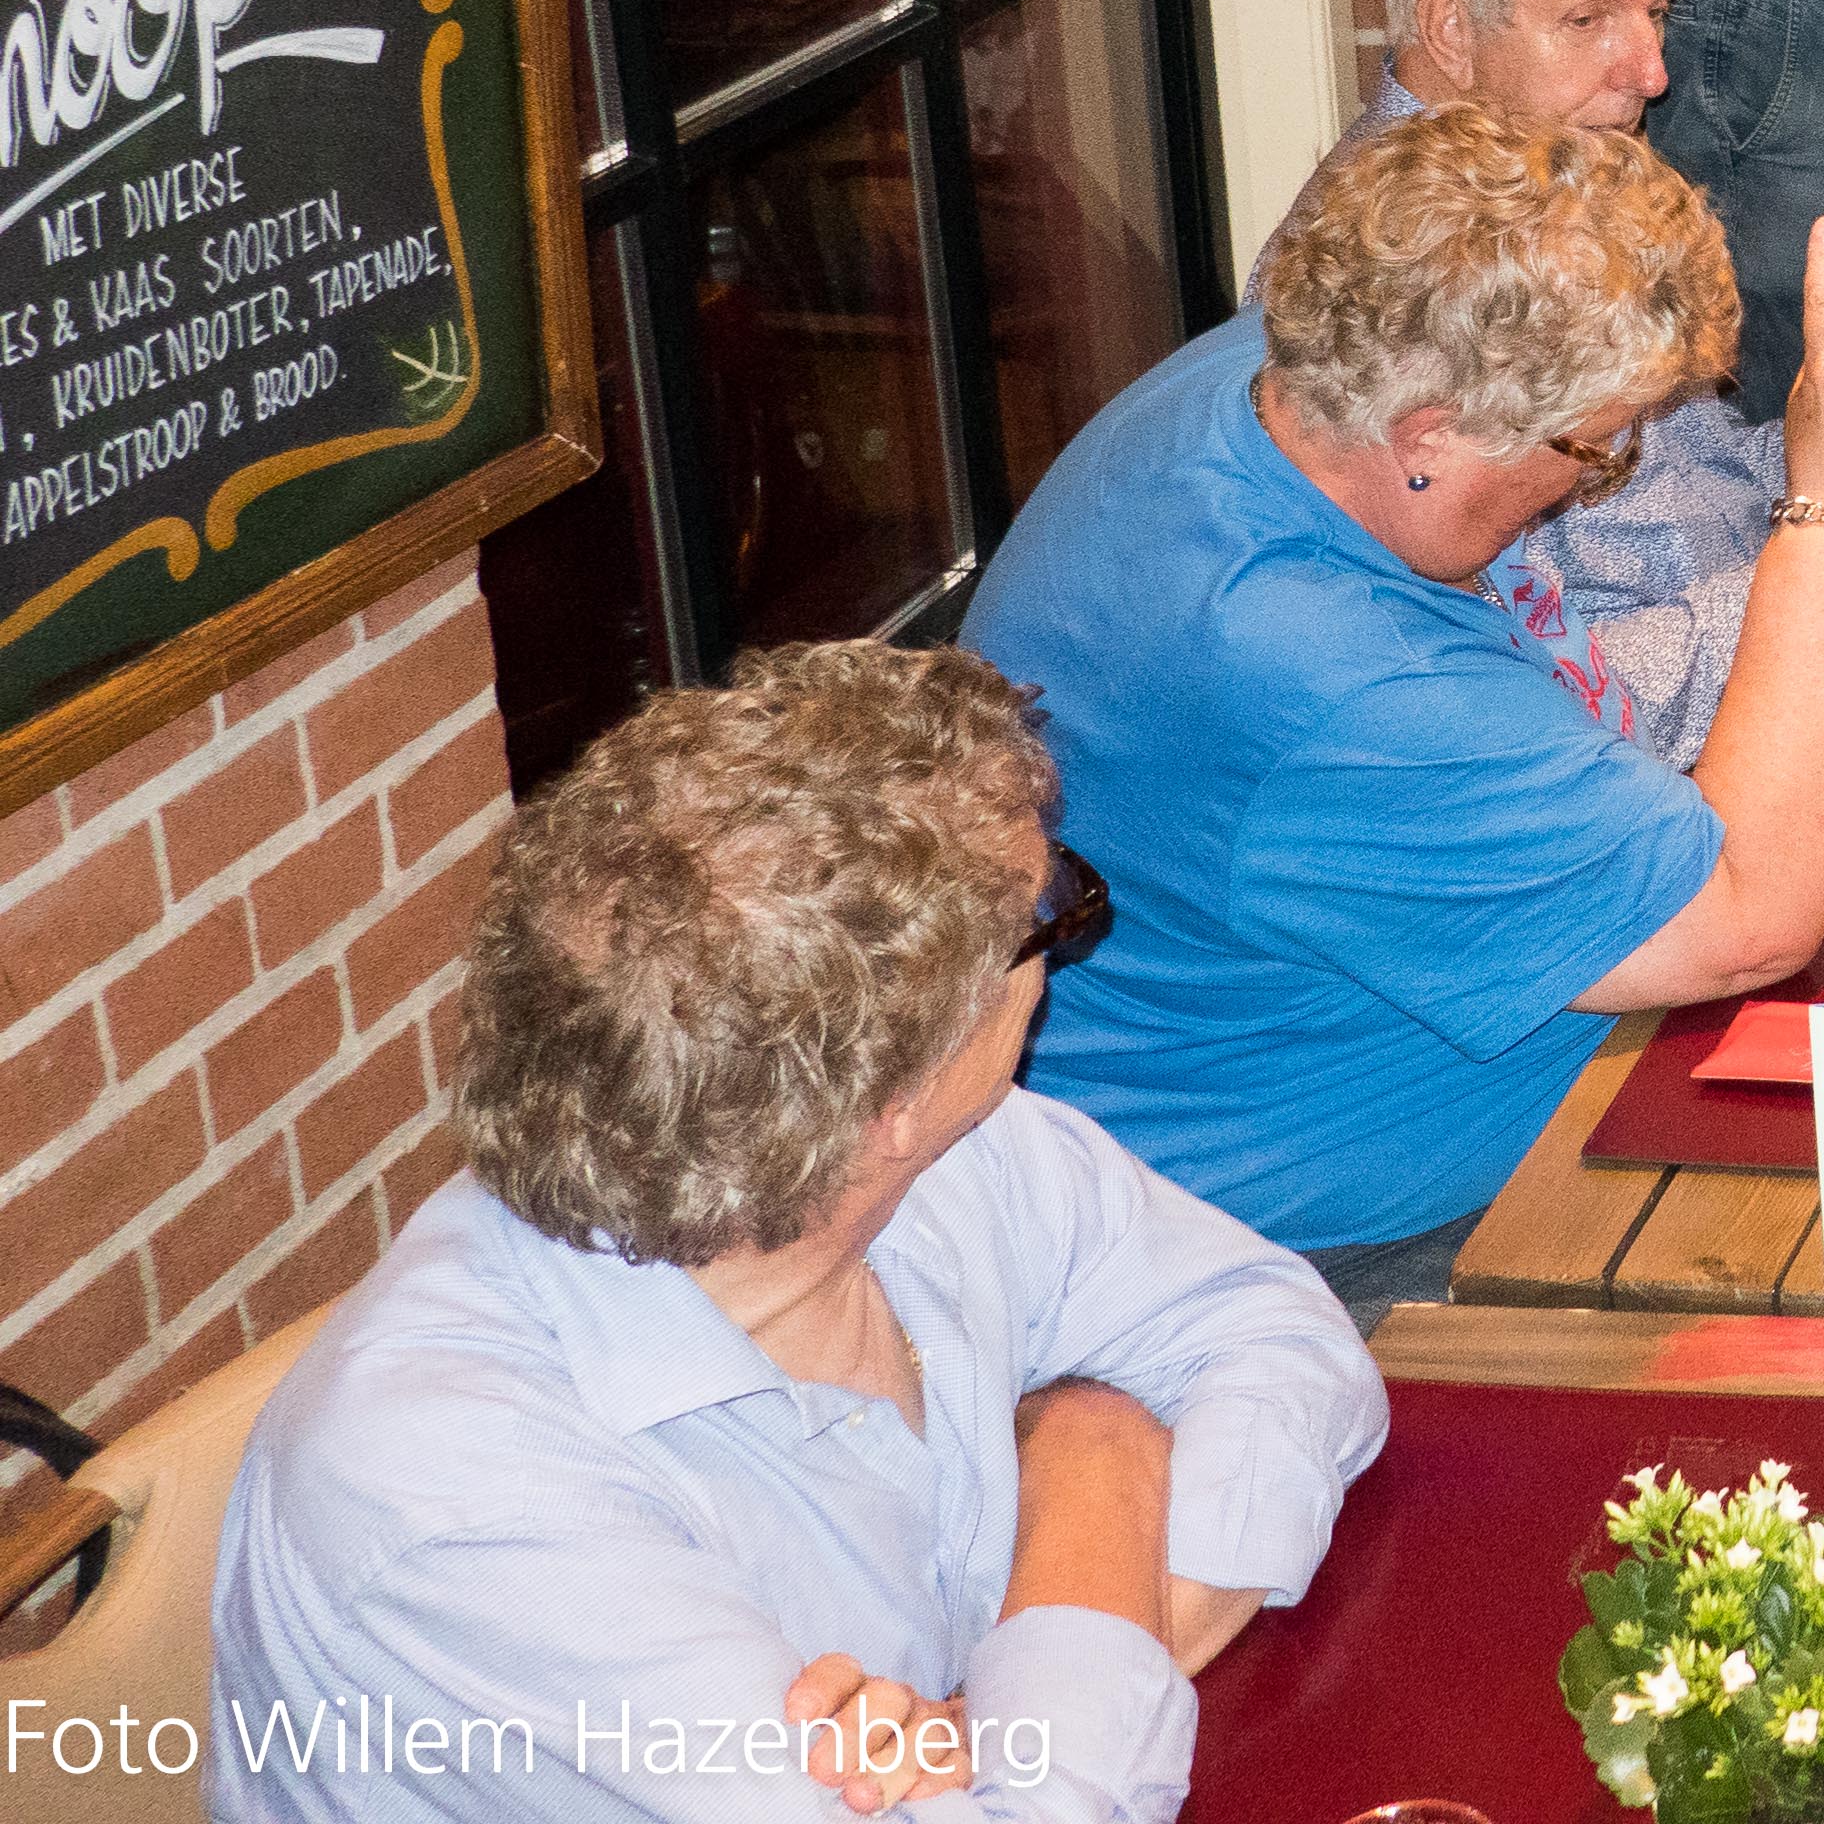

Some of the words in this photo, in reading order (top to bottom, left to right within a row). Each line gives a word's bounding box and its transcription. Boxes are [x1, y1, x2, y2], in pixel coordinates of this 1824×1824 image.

[39, 191, 107, 266] MET
[122, 146, 247, 239] DIVERSE
[52, 297, 80, 347] &
[89, 253, 177, 333] KAAS
[4, 401, 207, 545] APPELSTROOP
[219, 386, 243, 438] &
